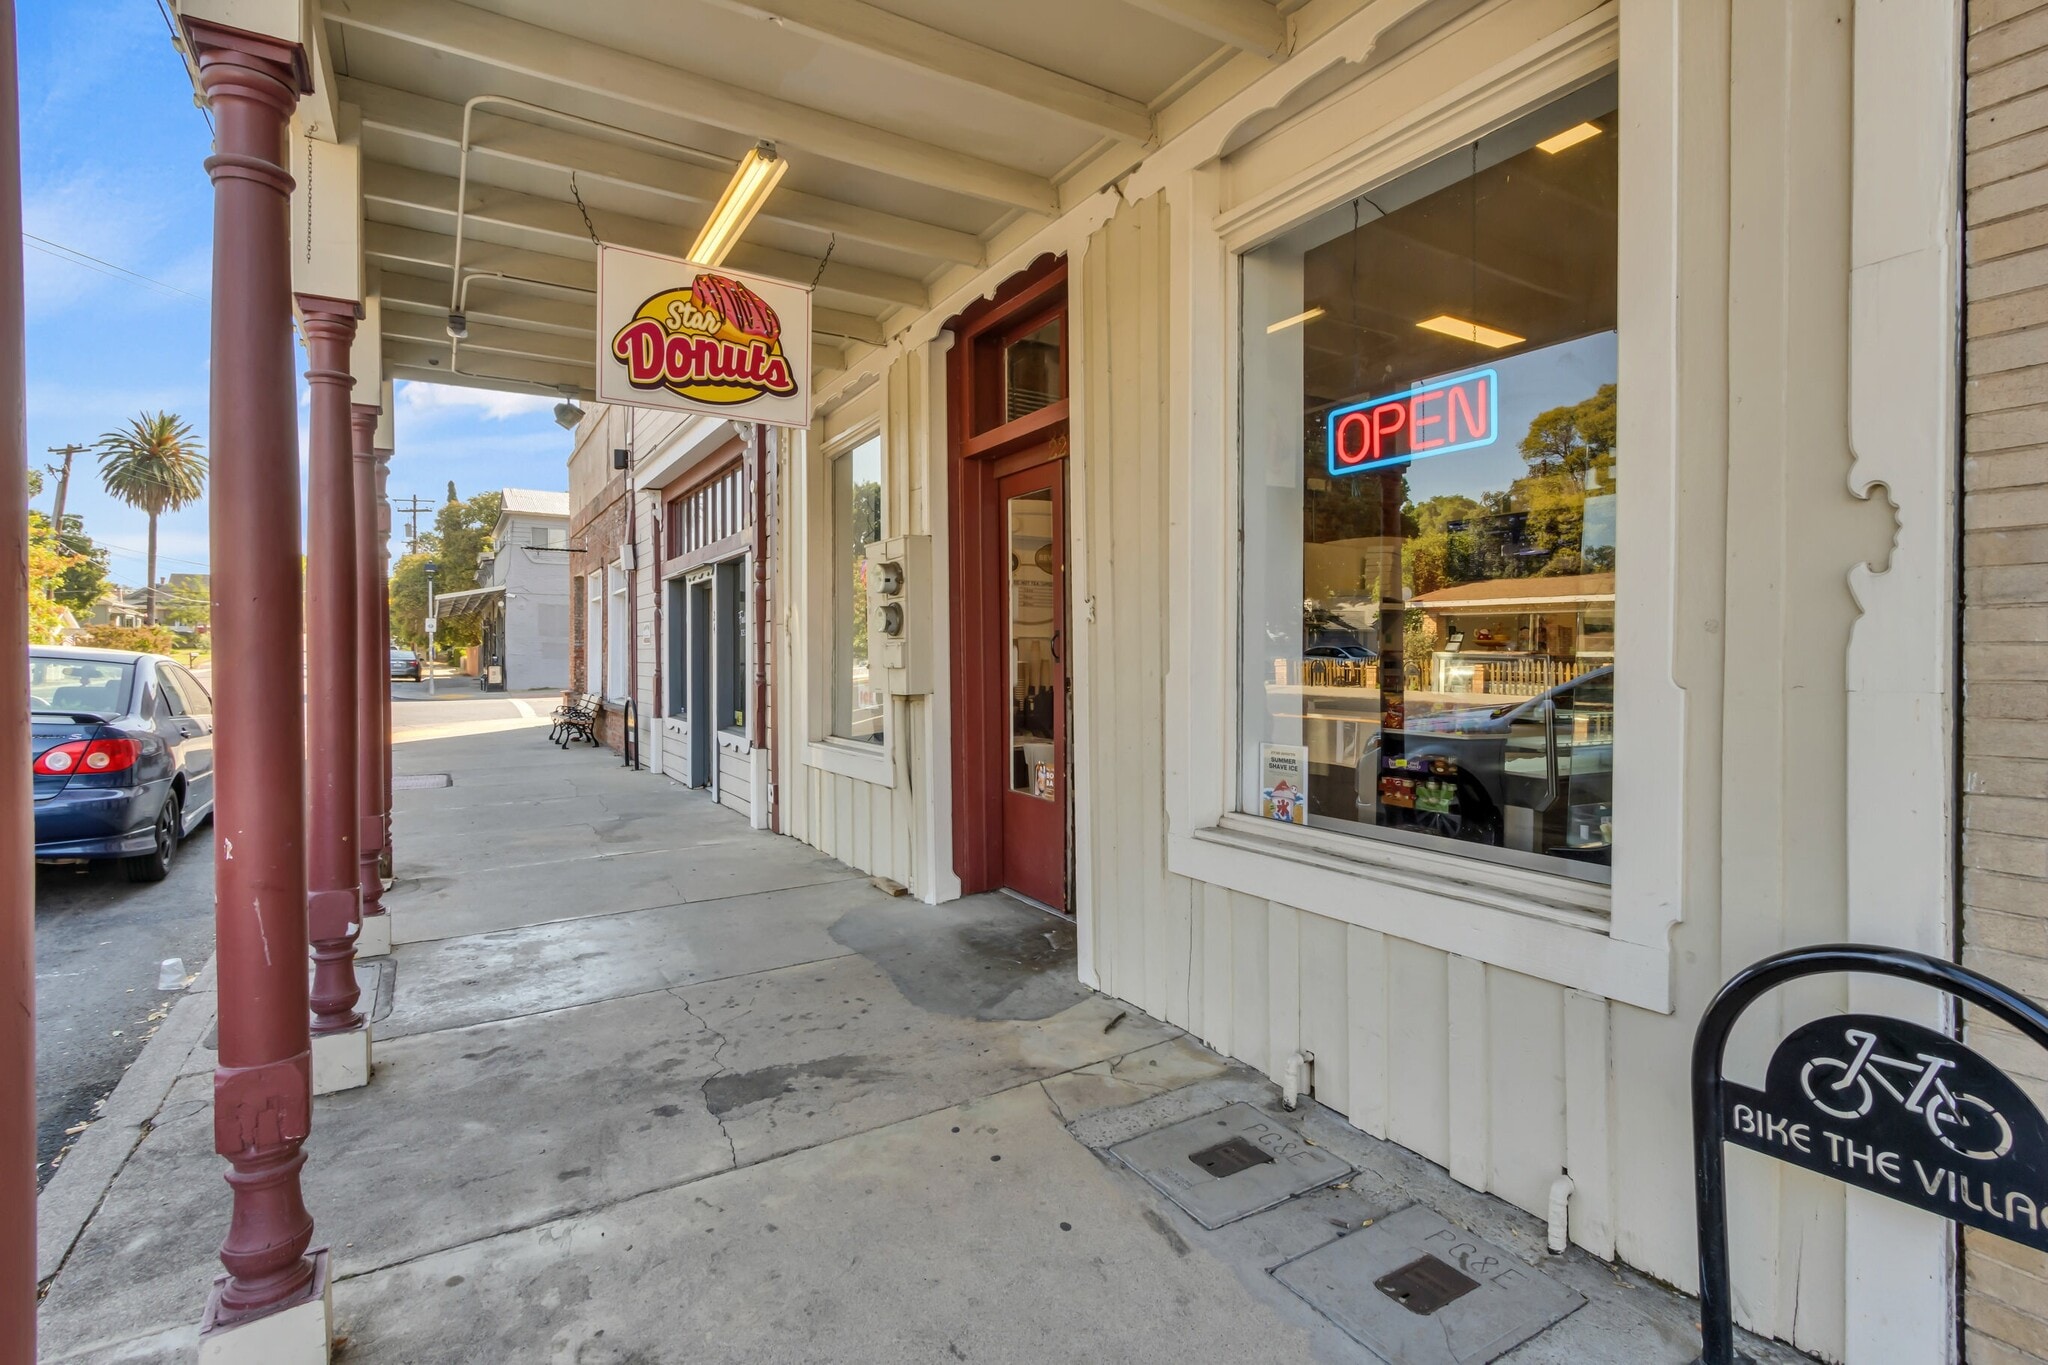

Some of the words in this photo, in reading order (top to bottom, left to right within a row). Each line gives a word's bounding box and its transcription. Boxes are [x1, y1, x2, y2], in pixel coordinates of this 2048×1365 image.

[665, 300, 721, 334] Star
[614, 319, 793, 391] Donuts
[1336, 379, 1487, 464] OPEN
[1268, 762, 1287, 771] SHAVE
[1270, 756, 1296, 765] SUMMER
[1242, 1123, 1319, 1166] PG&E
[1733, 1104, 1811, 1153] BIKE
[1823, 1131, 1900, 1183] THE
[1913, 1159, 2048, 1231] VILLA
[1424, 1229, 1529, 1291] PG&E
